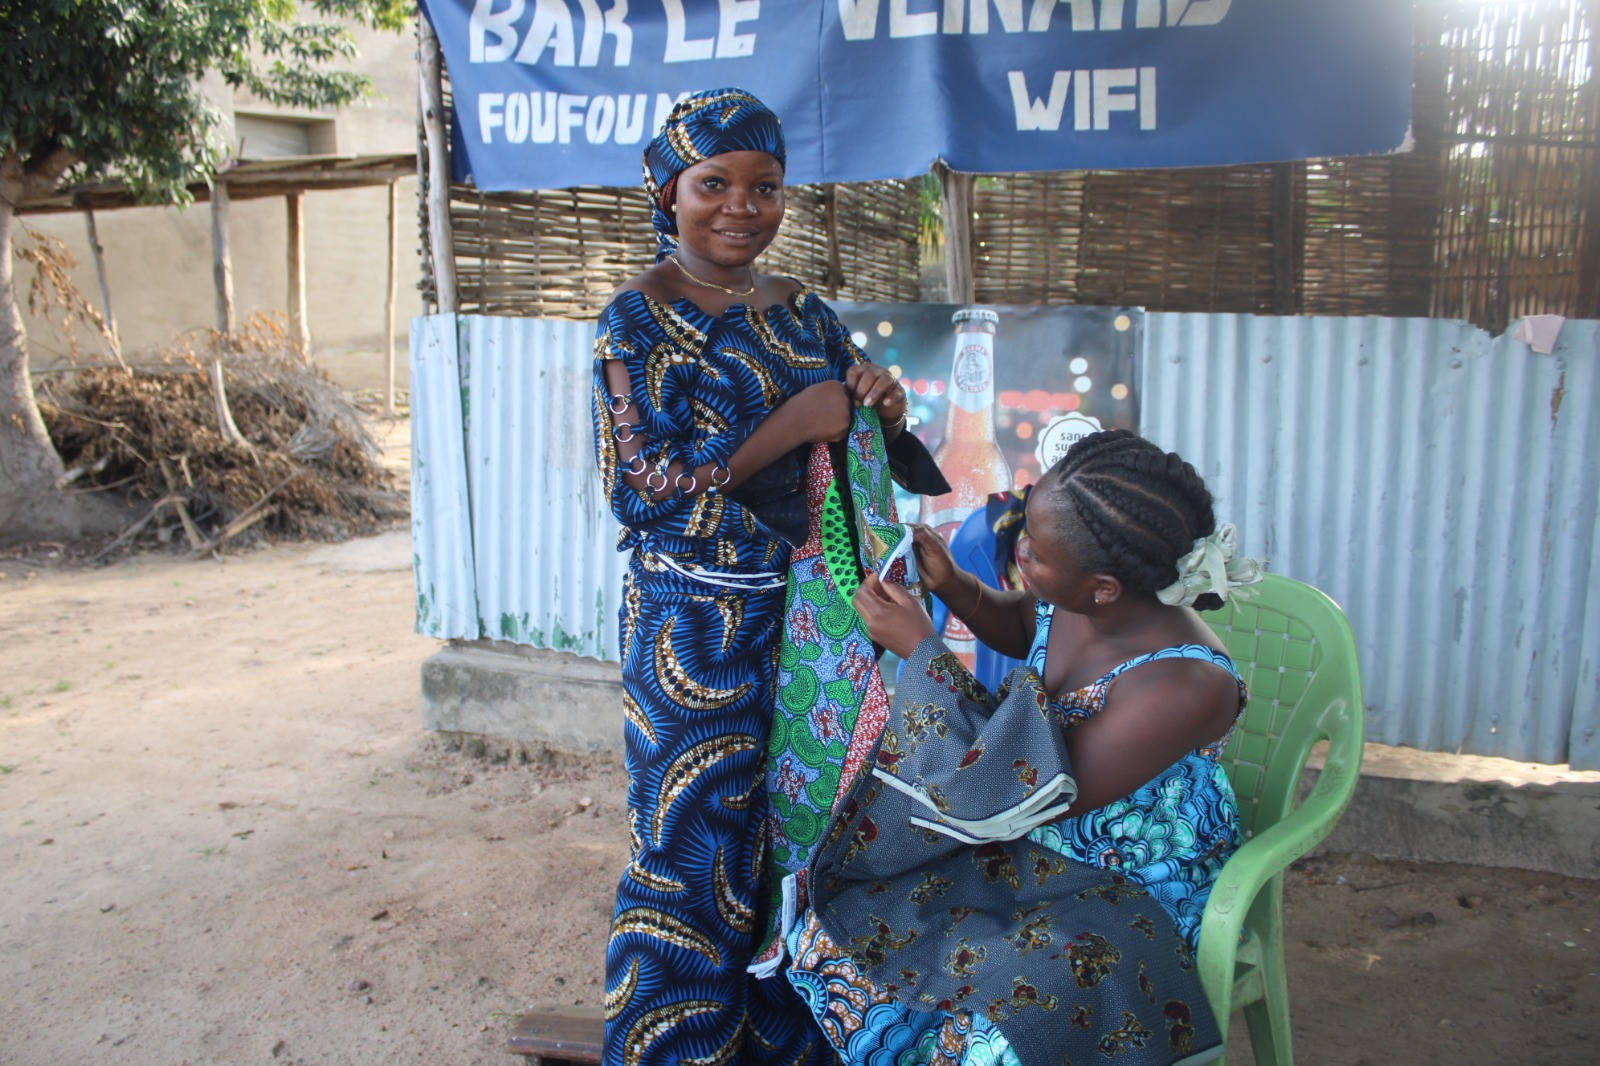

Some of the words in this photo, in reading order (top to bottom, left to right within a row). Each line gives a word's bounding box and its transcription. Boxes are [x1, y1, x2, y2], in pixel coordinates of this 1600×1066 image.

[469, 0, 633, 67] BAR
[663, 0, 760, 63] LE
[1008, 67, 1156, 131] WIFI
